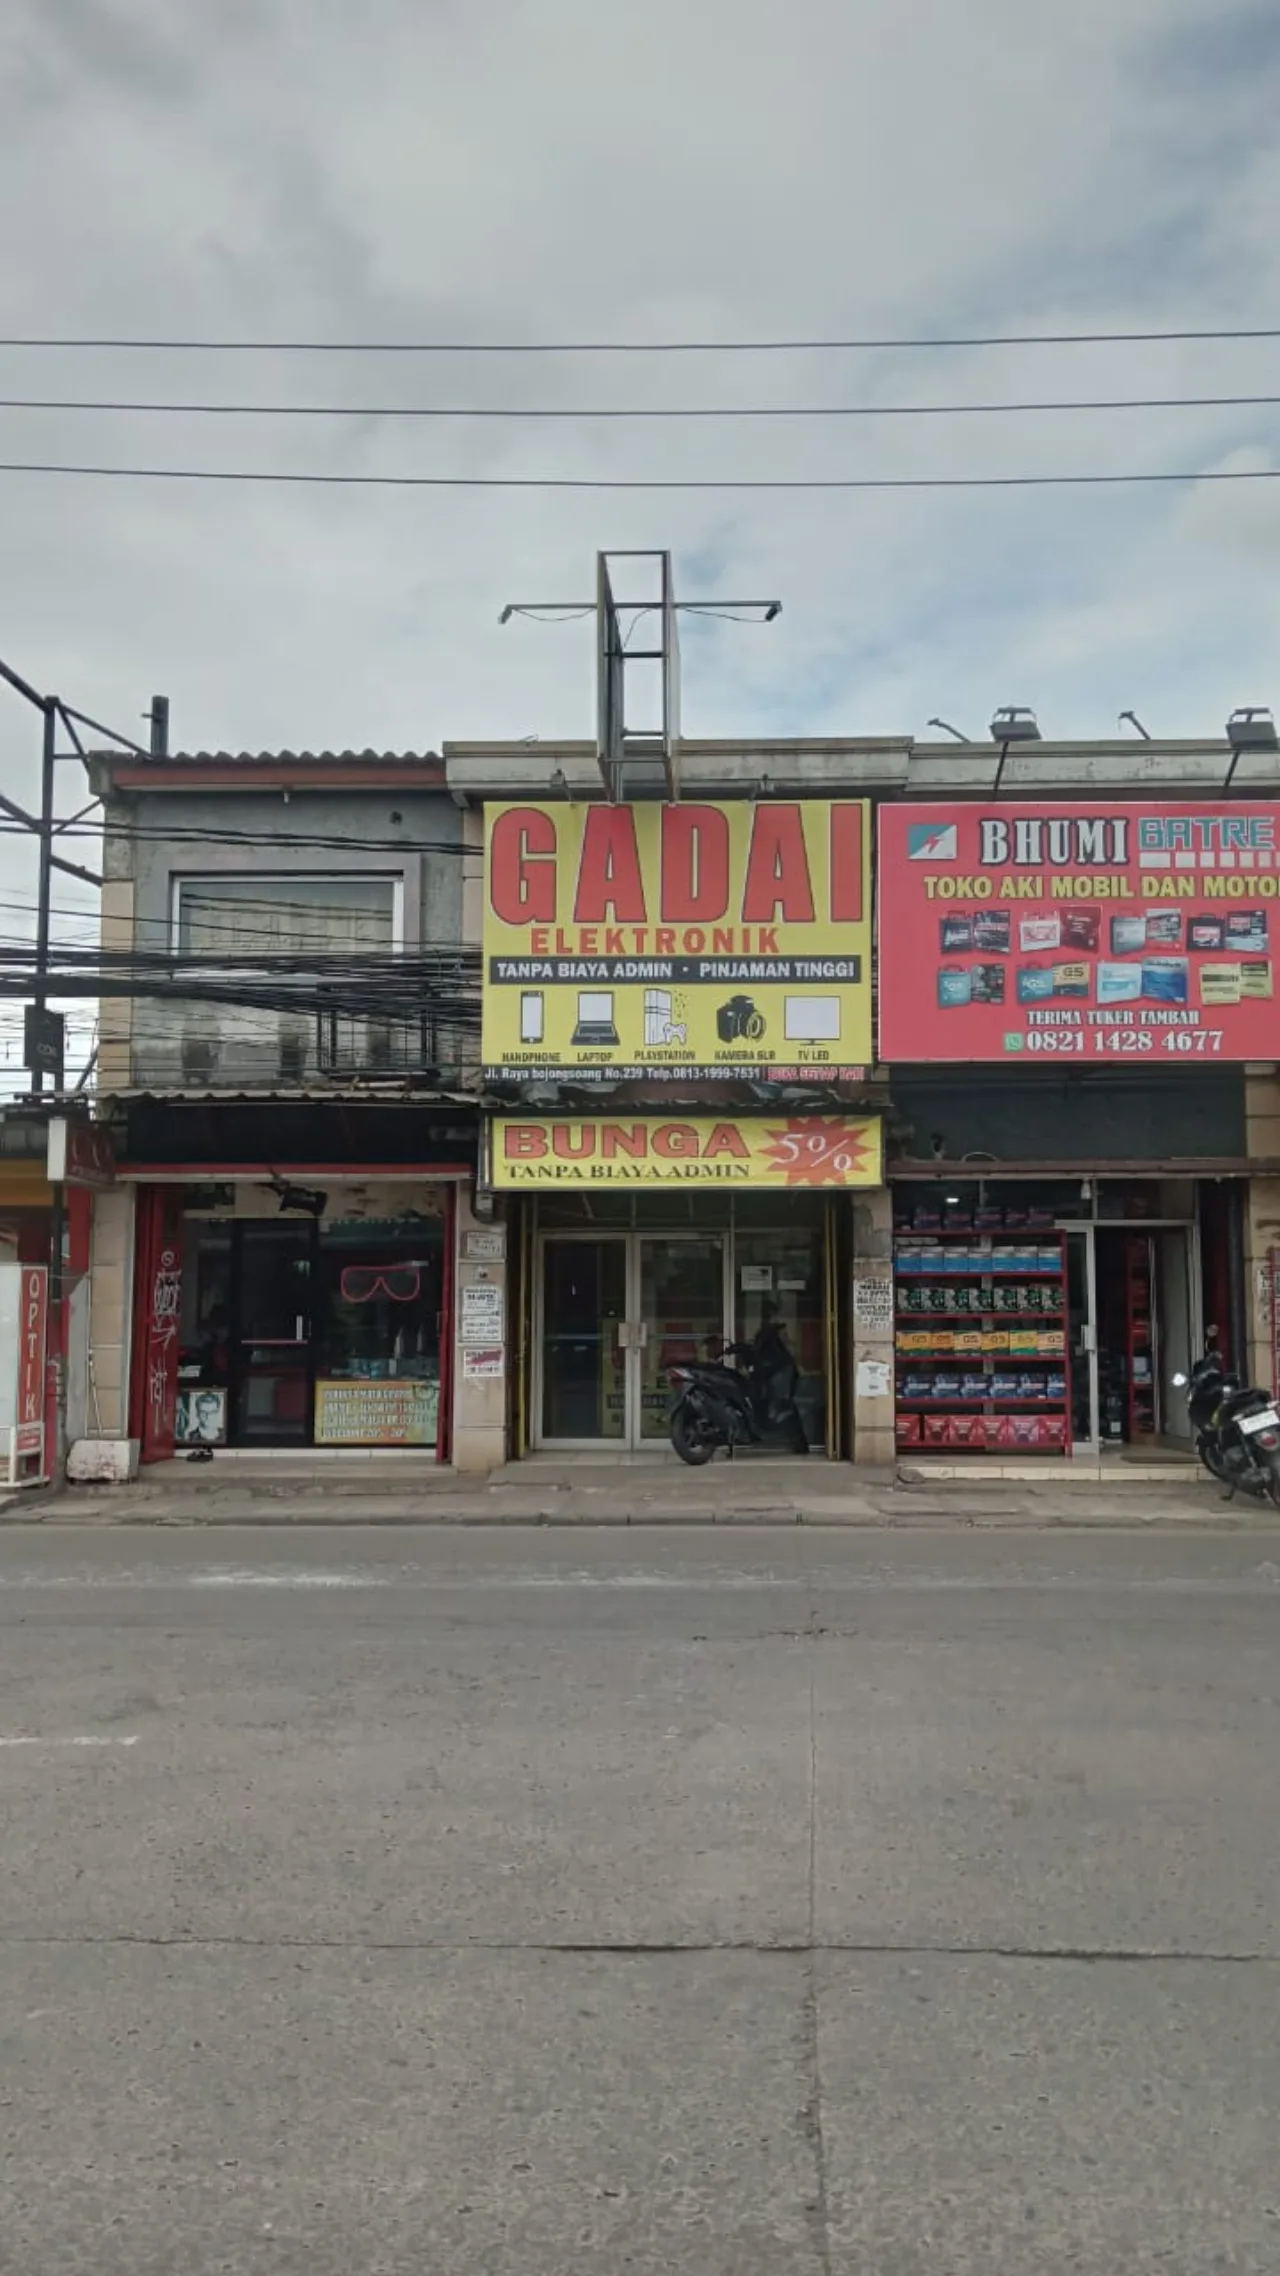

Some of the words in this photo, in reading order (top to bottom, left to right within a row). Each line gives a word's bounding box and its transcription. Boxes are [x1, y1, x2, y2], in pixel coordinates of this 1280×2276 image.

[979, 817, 1130, 866] BHUMI
[1138, 816, 1276, 850] BATRE
[490, 804, 863, 924] GADAI
[924, 875, 993, 899] TOKO
[1000, 875, 1043, 898] AKI
[1051, 875, 1135, 898] MOBIL
[1141, 875, 1196, 897] DAN
[1203, 875, 1280, 897] MOTO
[531, 927, 779, 955] ELEKTRONIK
[497, 963, 553, 978] TANPA
[558, 963, 608, 978] BIAYA
[613, 962, 672, 978] ADMIN
[700, 962, 790, 977] PINJAMAN
[794, 962, 855, 977] TINGGI
[1027, 1010, 1082, 1025] TERIMA
[1087, 1010, 1134, 1025] TUKER
[1139, 1010, 1199, 1025] TAMBAH
[1027, 1030, 1084, 1051] 0821
[1094, 1030, 1153, 1051] 1428
[1161, 1030, 1223, 1051] 4677
[502, 1052, 561, 1063] HANDPHONE
[577, 1052, 613, 1062] LAPTOP
[634, 1050, 696, 1061] PLAYSTATION
[714, 1050, 755, 1061] KAMERA
[798, 1050, 809, 1061] TV
[812, 1050, 829, 1061] LED
[485, 1067, 498, 1079] Jl.
[502, 1067, 529, 1082] Raya
[504, 1123, 751, 1160] BUNGA
[774, 1134, 853, 1172] 5%
[505, 1165, 584, 1179] TANPA
[590, 1165, 663, 1178] BIAYA
[666, 1164, 750, 1178] ADMIN
[25, 1271, 41, 1421] OPTIK
